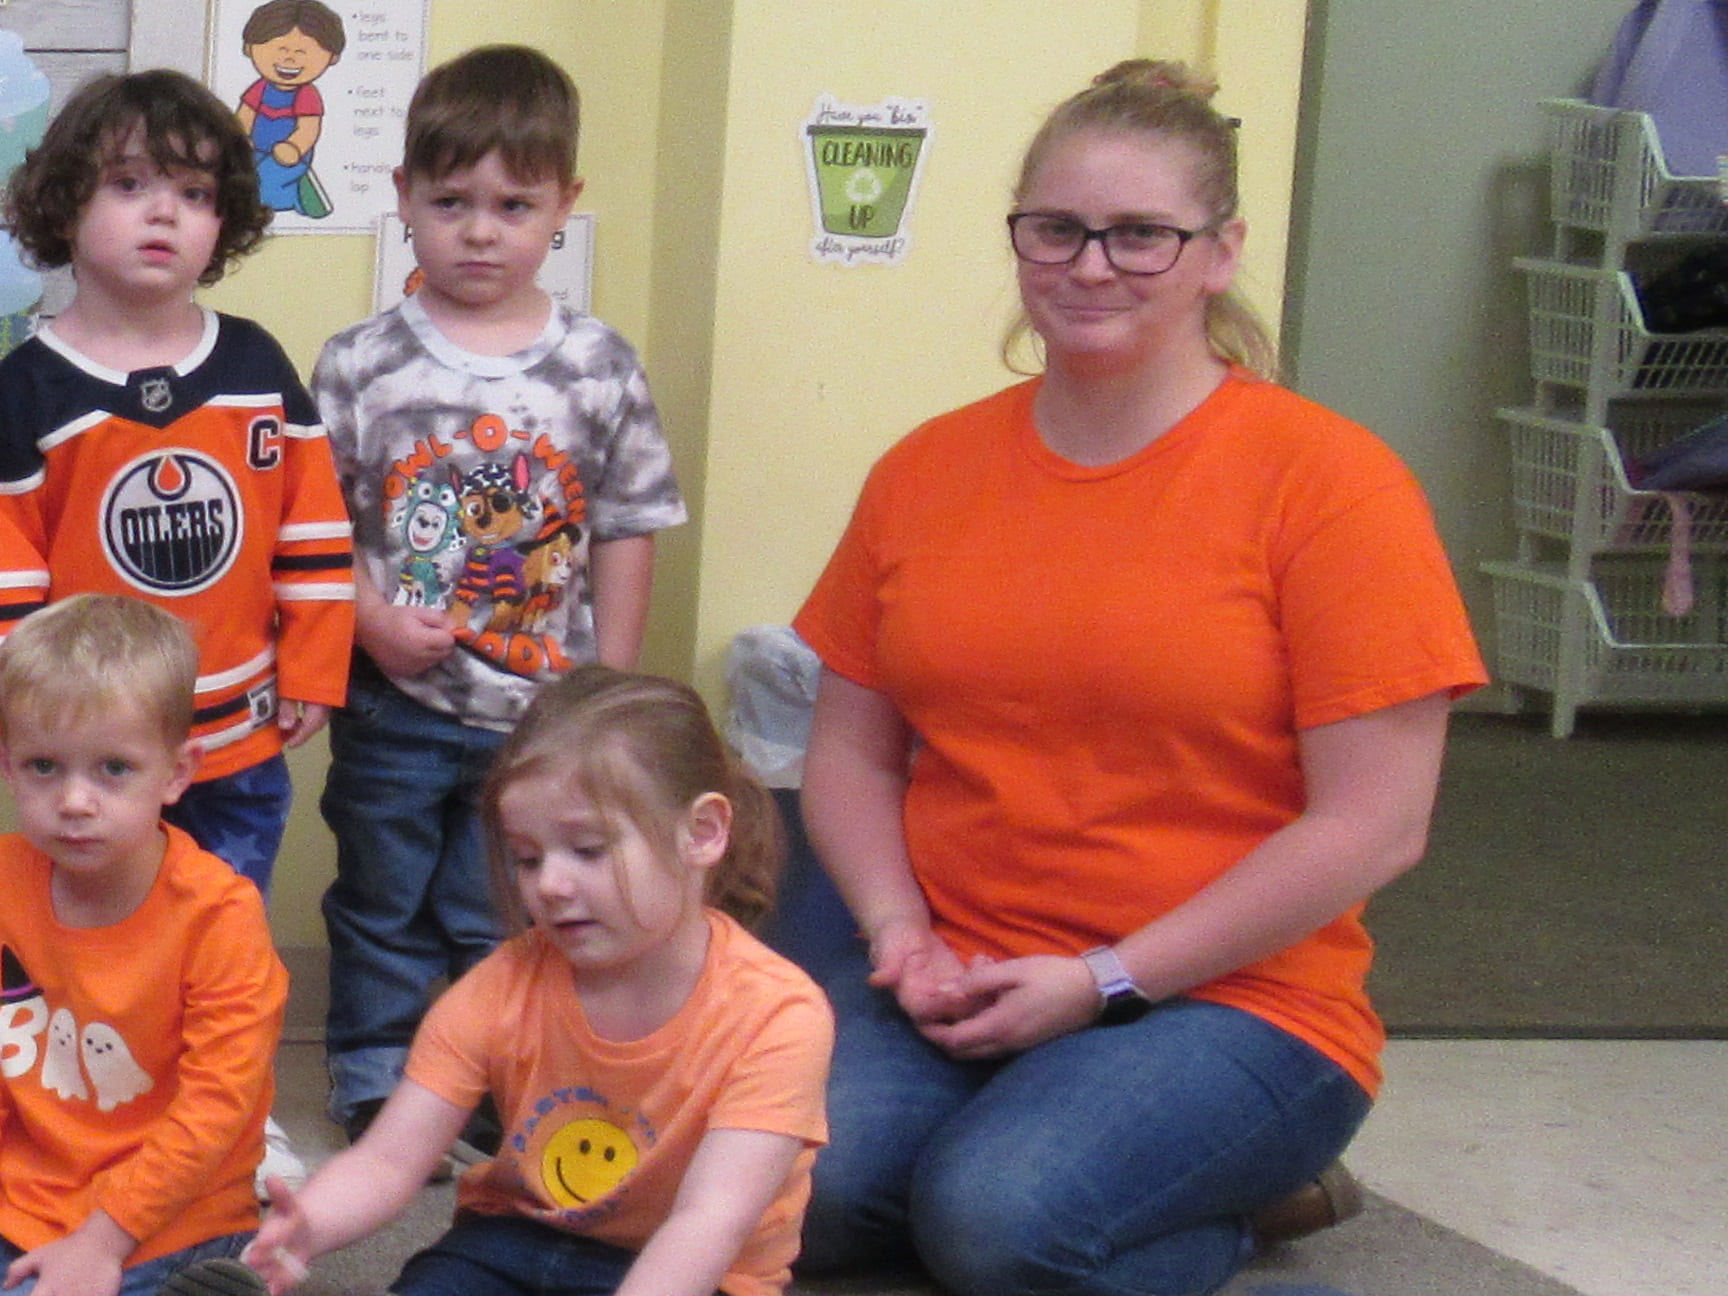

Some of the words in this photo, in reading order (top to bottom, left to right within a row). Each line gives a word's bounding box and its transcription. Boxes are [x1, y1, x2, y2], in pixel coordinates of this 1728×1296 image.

[823, 141, 913, 168] CLEANING
[848, 204, 876, 230] UP
[246, 414, 284, 473] C
[119, 499, 226, 546] OILERS
